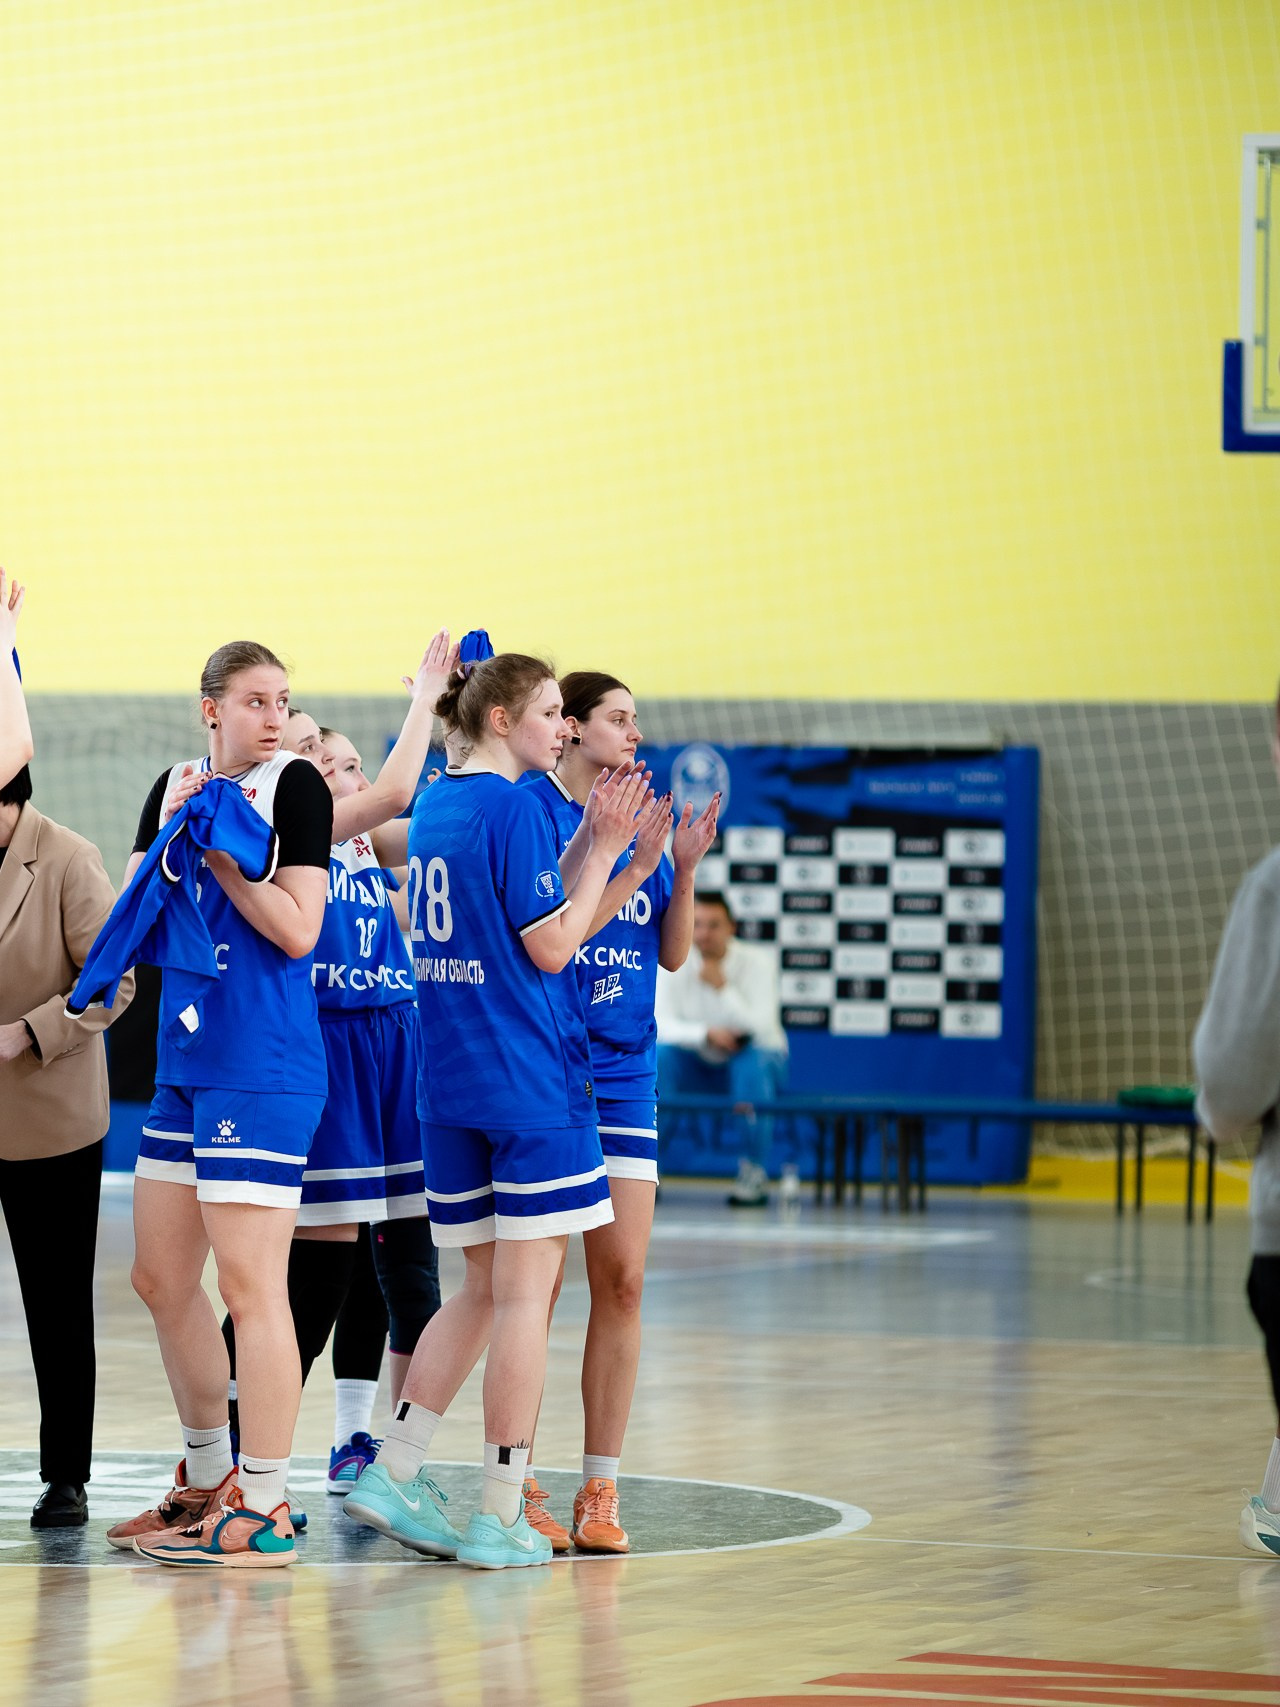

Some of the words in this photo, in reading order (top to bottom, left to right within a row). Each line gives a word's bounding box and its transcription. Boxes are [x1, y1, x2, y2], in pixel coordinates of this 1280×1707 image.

[409, 856, 453, 942] 28
[594, 947, 643, 970] СМСС
[311, 963, 347, 989] ГК
